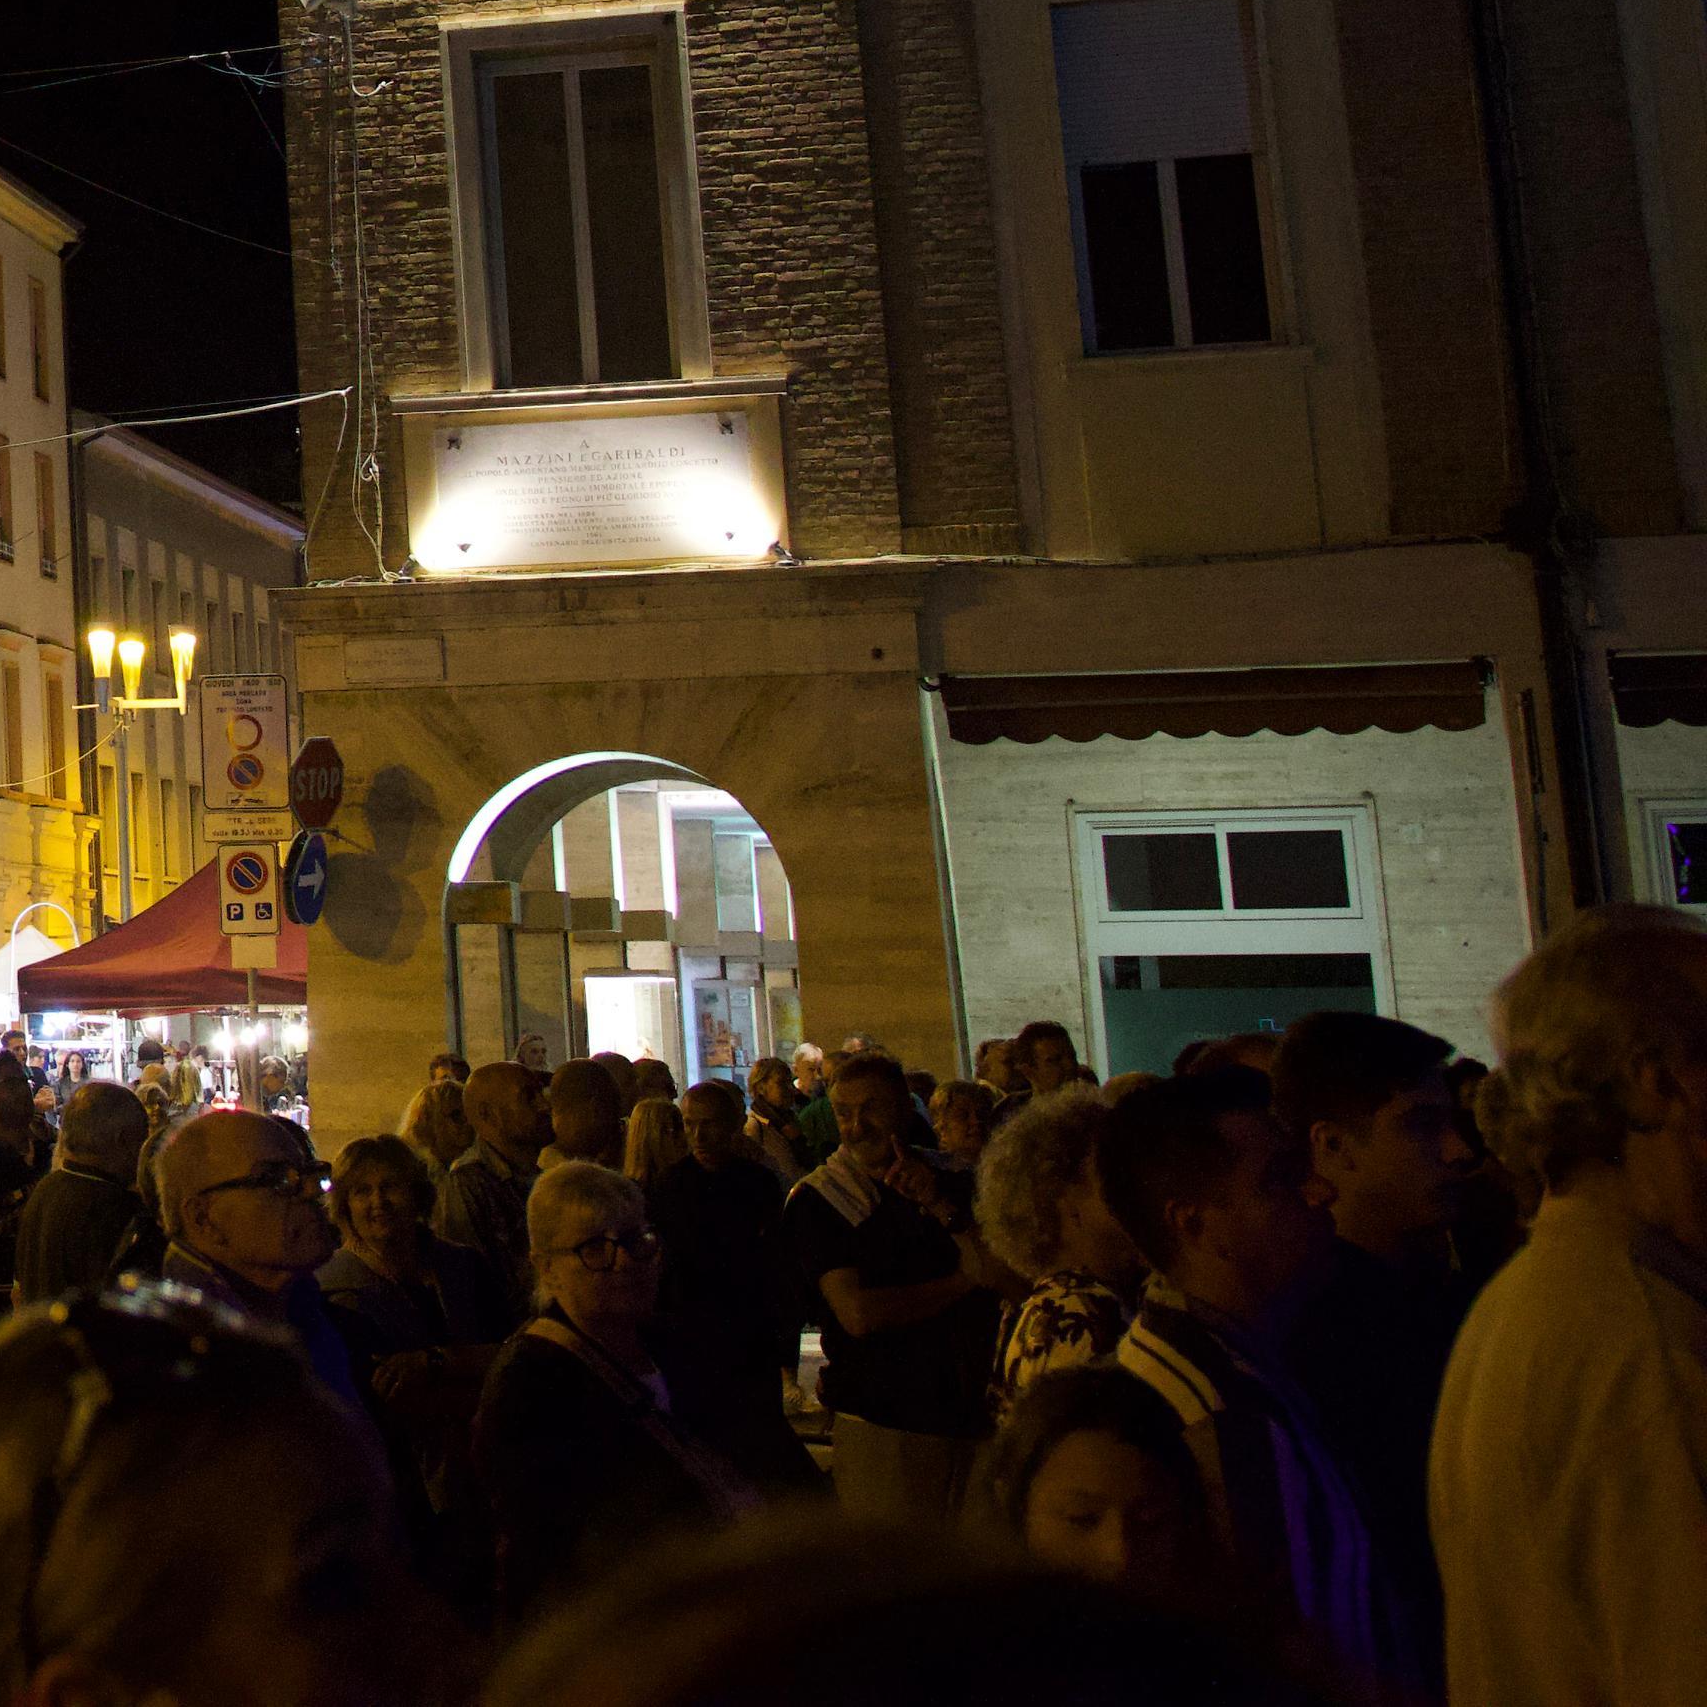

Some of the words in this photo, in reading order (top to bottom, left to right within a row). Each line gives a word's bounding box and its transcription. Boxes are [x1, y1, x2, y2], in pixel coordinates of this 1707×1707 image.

[496, 452, 573, 467] MAZZINI
[591, 446, 686, 462] GARIBALDI
[295, 766, 341, 801] STOP
